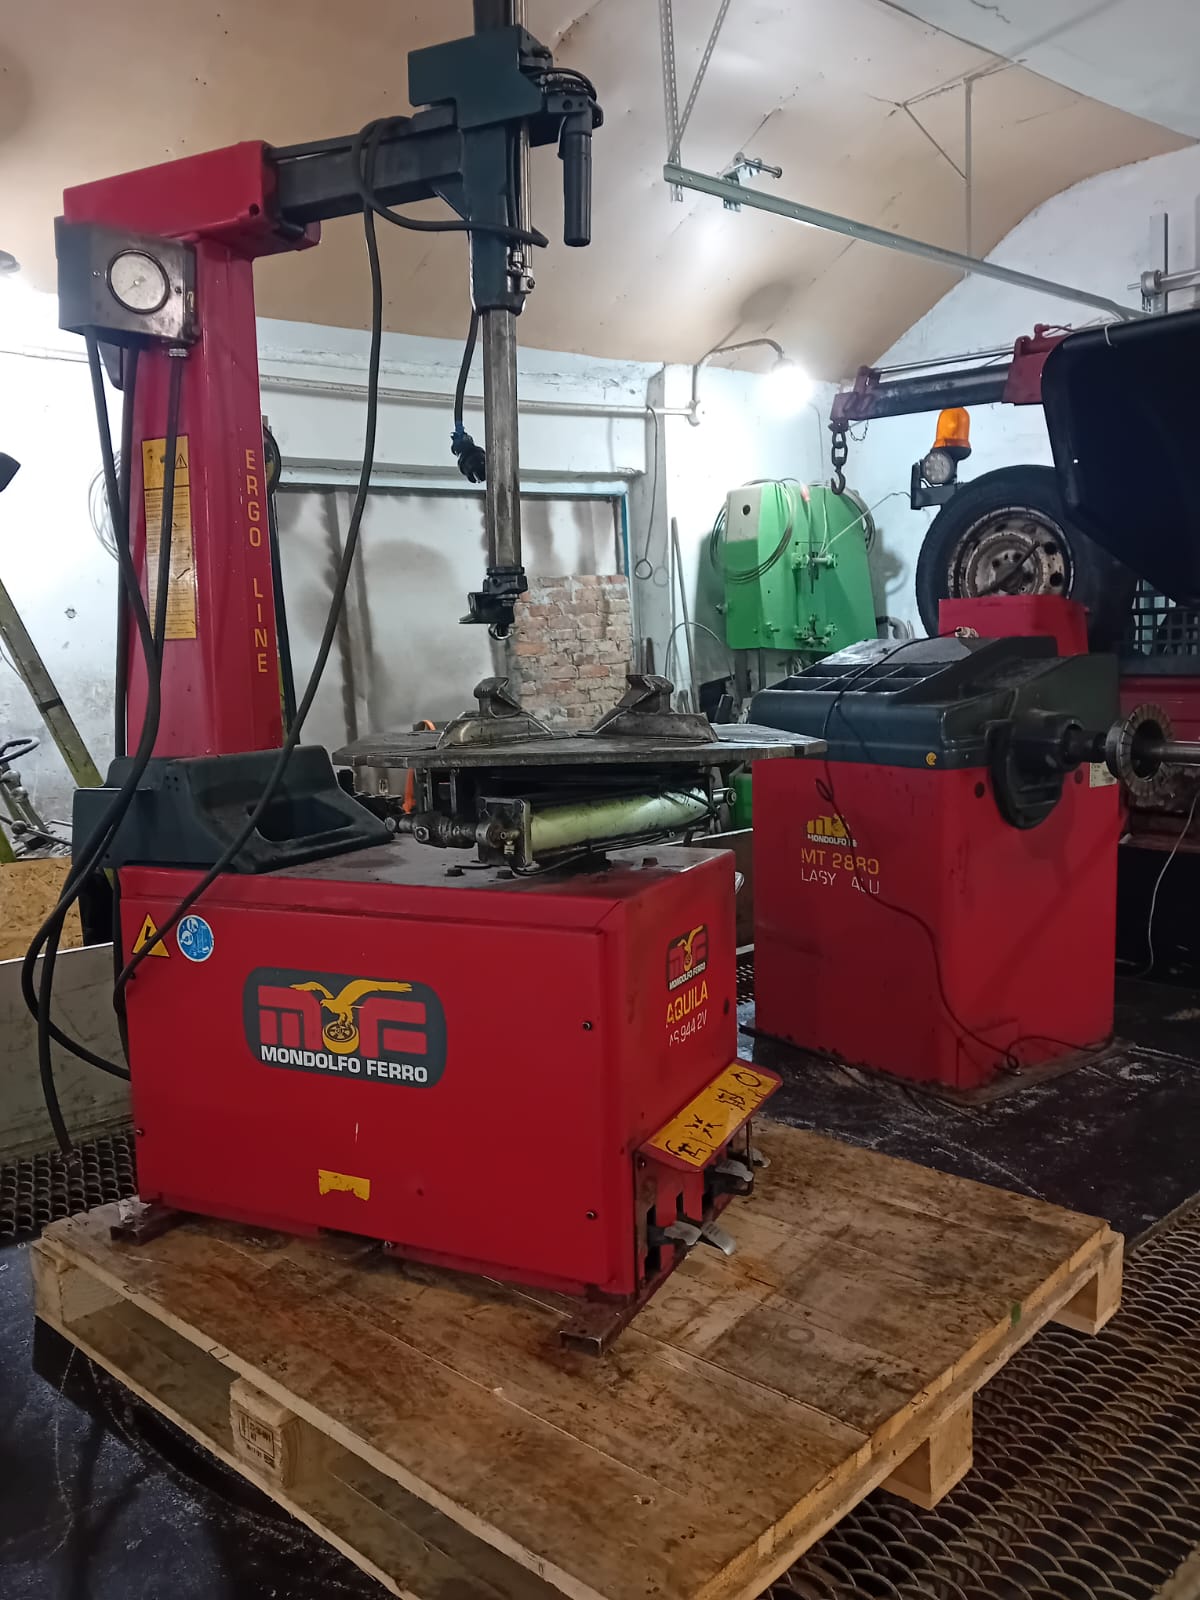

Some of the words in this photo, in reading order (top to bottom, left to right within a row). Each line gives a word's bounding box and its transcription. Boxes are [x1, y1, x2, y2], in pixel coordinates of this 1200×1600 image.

[245, 449, 261, 548] ERGO
[253, 577, 269, 673] LINE
[801, 847, 827, 866] MT
[669, 969, 693, 991] MONDOLFO
[665, 979, 709, 1024] AQUILA
[261, 1045, 361, 1075] MONDOLFO
[366, 1058, 429, 1084] FERRO
